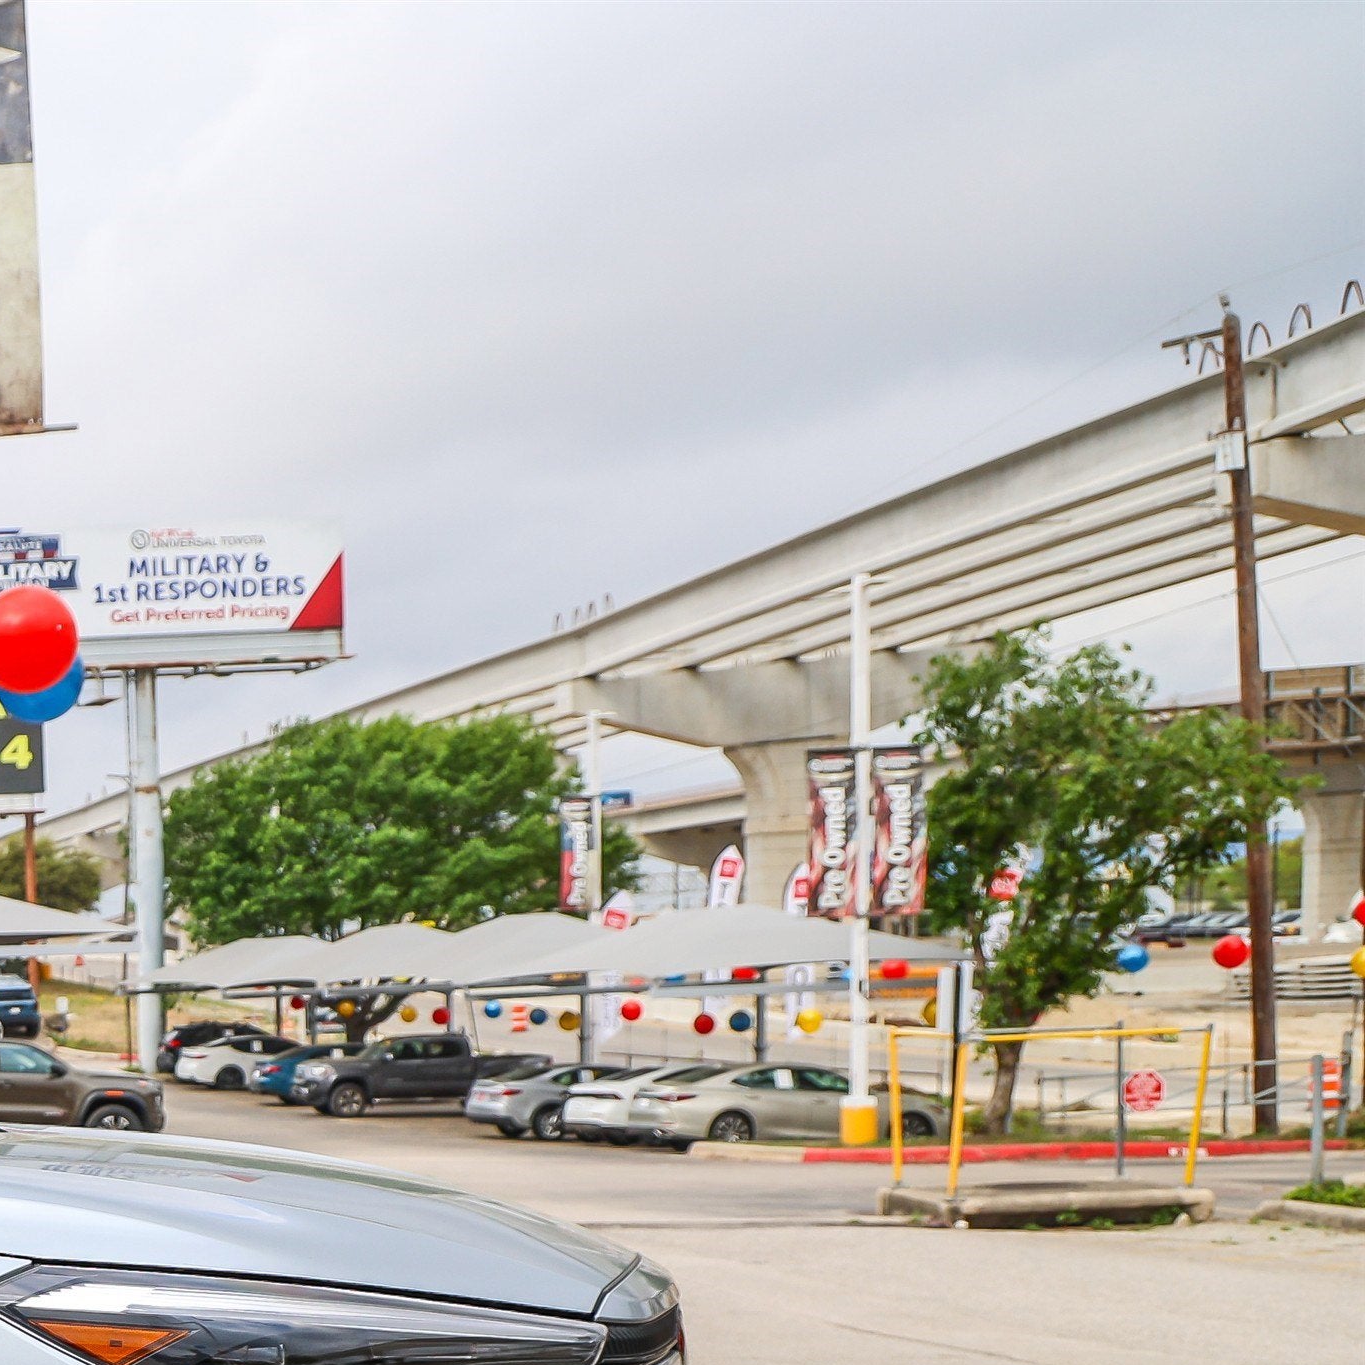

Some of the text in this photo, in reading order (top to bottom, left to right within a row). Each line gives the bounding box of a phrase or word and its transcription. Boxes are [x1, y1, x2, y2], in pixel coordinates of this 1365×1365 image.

[152, 534, 267, 549] UNIVERSAL TOYOTA
[129, 552, 269, 577] MILITARY &
[94, 574, 306, 603] 1st RESPONDERS
[110, 603, 290, 623] Get Preferred Pricing
[819, 786, 847, 869] Owned
[884, 783, 912, 866] Owned
[817, 868, 846, 910] Pre
[882, 866, 911, 907] Pre
